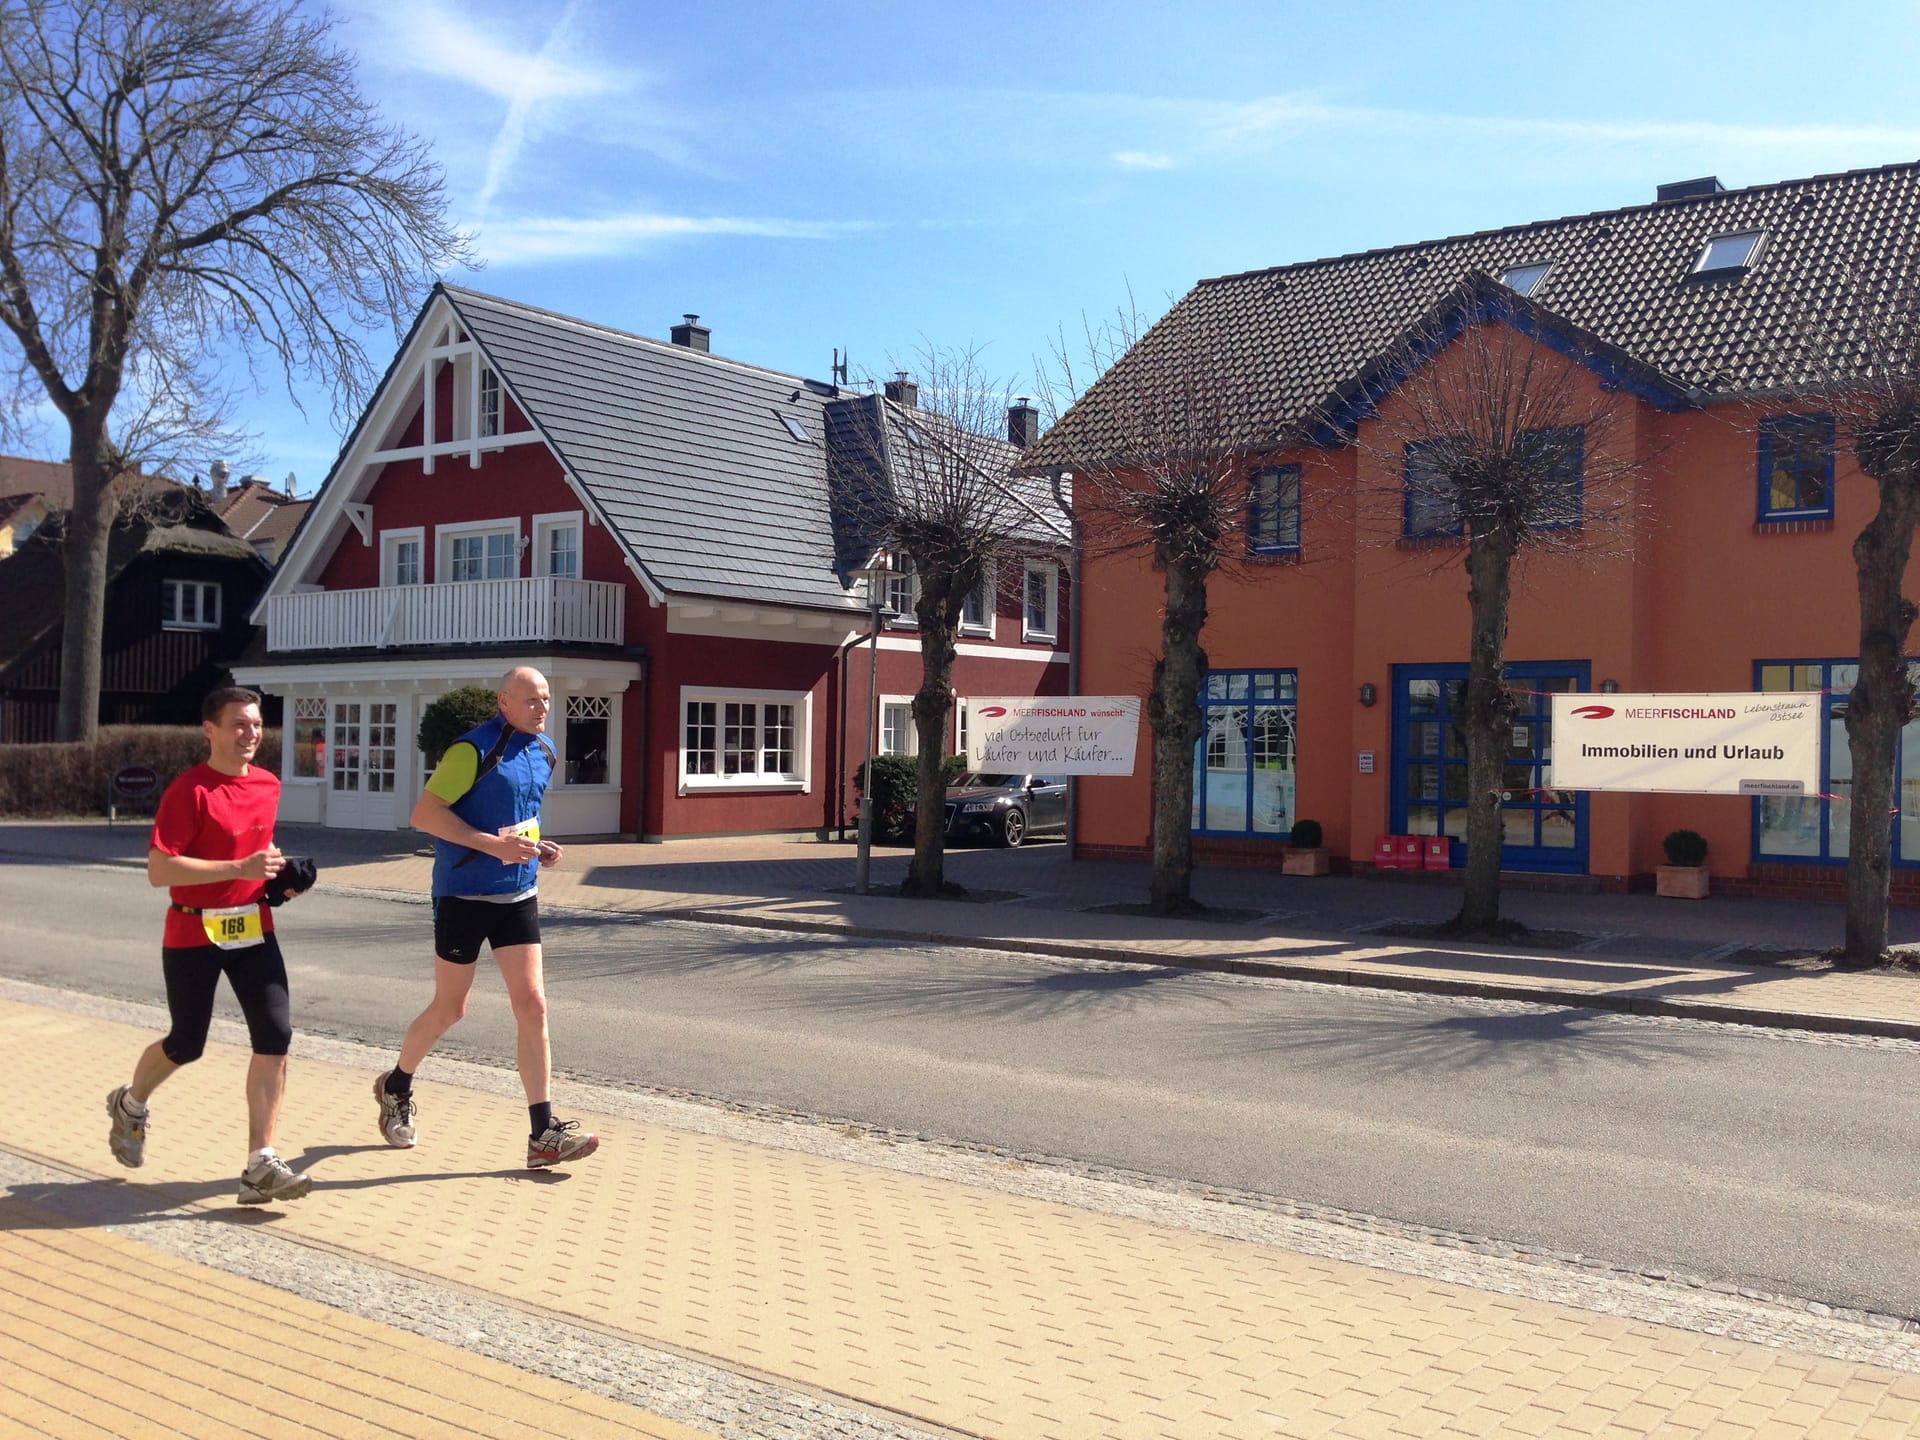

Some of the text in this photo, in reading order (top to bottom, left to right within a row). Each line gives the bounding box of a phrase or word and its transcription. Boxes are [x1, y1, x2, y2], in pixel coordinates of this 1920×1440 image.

[1012, 708, 1087, 718] MEERFISCHLAND
[1625, 708, 1736, 719] MEERFISCHLAND
[1744, 701, 1812, 714] Lebenstraum
[1769, 711, 1805, 722] Ostsee
[984, 728, 1004, 743] viel
[1009, 726, 1073, 743] Ostseeluft
[976, 745, 1022, 762] Läufer
[1028, 747, 1058, 762] und
[1582, 743, 1785, 760] Immobilien und Urlaub
[220, 916, 246, 936] 168
